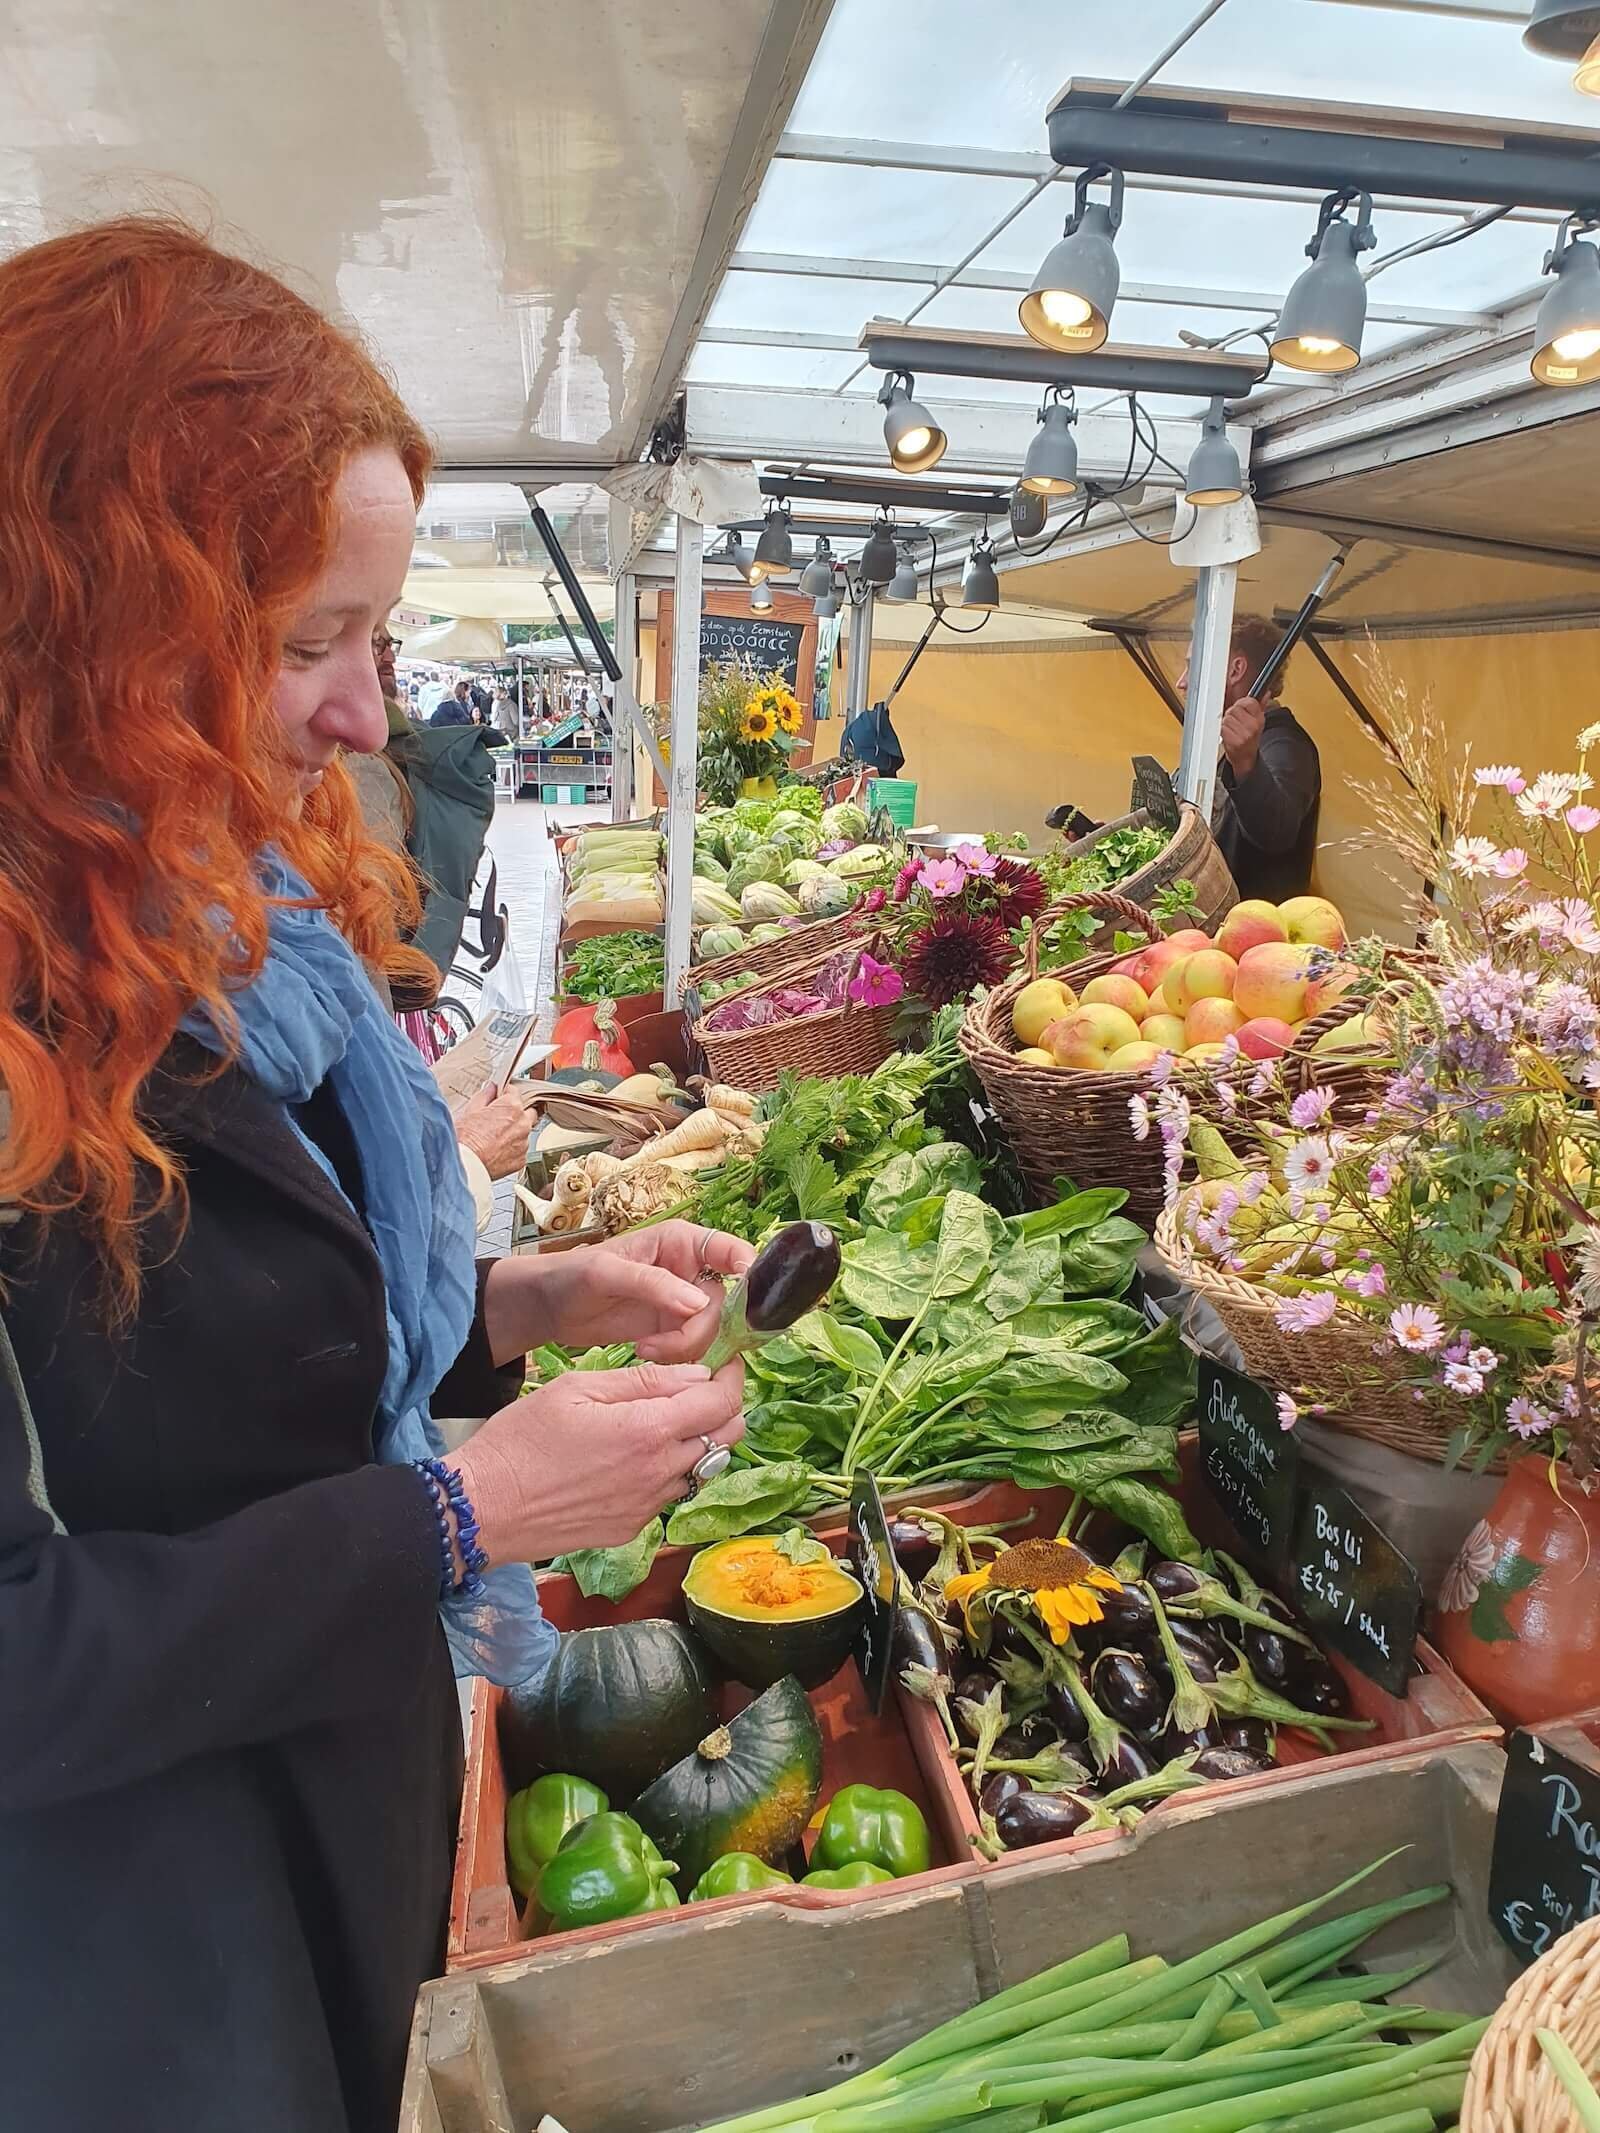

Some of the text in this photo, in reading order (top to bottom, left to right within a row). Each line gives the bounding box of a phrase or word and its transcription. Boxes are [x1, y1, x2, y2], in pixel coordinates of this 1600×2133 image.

[1207, 1378, 1280, 1472] Aubergine
[1315, 1503, 1339, 1547] Bos
[1324, 1549, 1339, 1573] Bio
